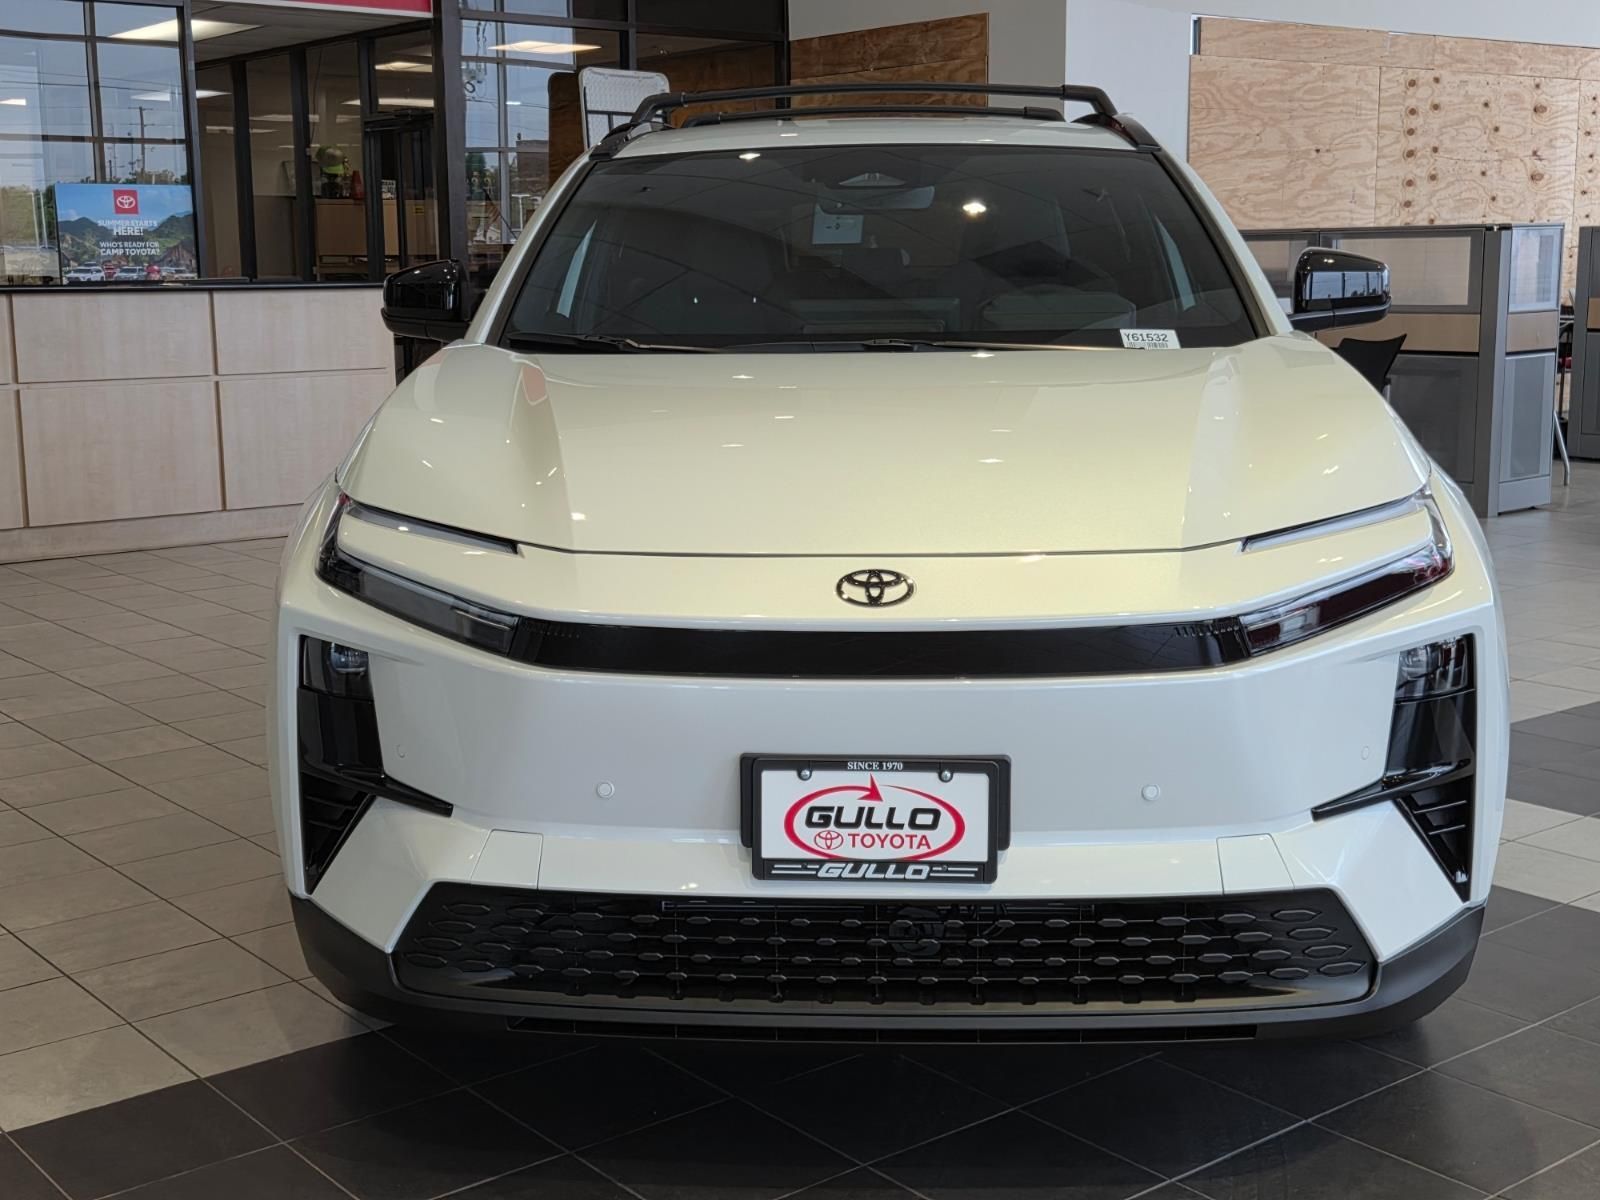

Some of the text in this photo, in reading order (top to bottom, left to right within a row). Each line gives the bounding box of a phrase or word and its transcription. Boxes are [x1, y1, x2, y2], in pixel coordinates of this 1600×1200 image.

[113, 226, 144, 236] HERE!
[100, 248, 161, 256] CAMP TOYOTA?
[1124, 333, 1169, 342] Y61532
[847, 761, 903, 771] SINCE 1970
[805, 806, 942, 831] GULLO
[848, 833, 932, 850] TOYOTA
[817, 863, 930, 880] GULLO
